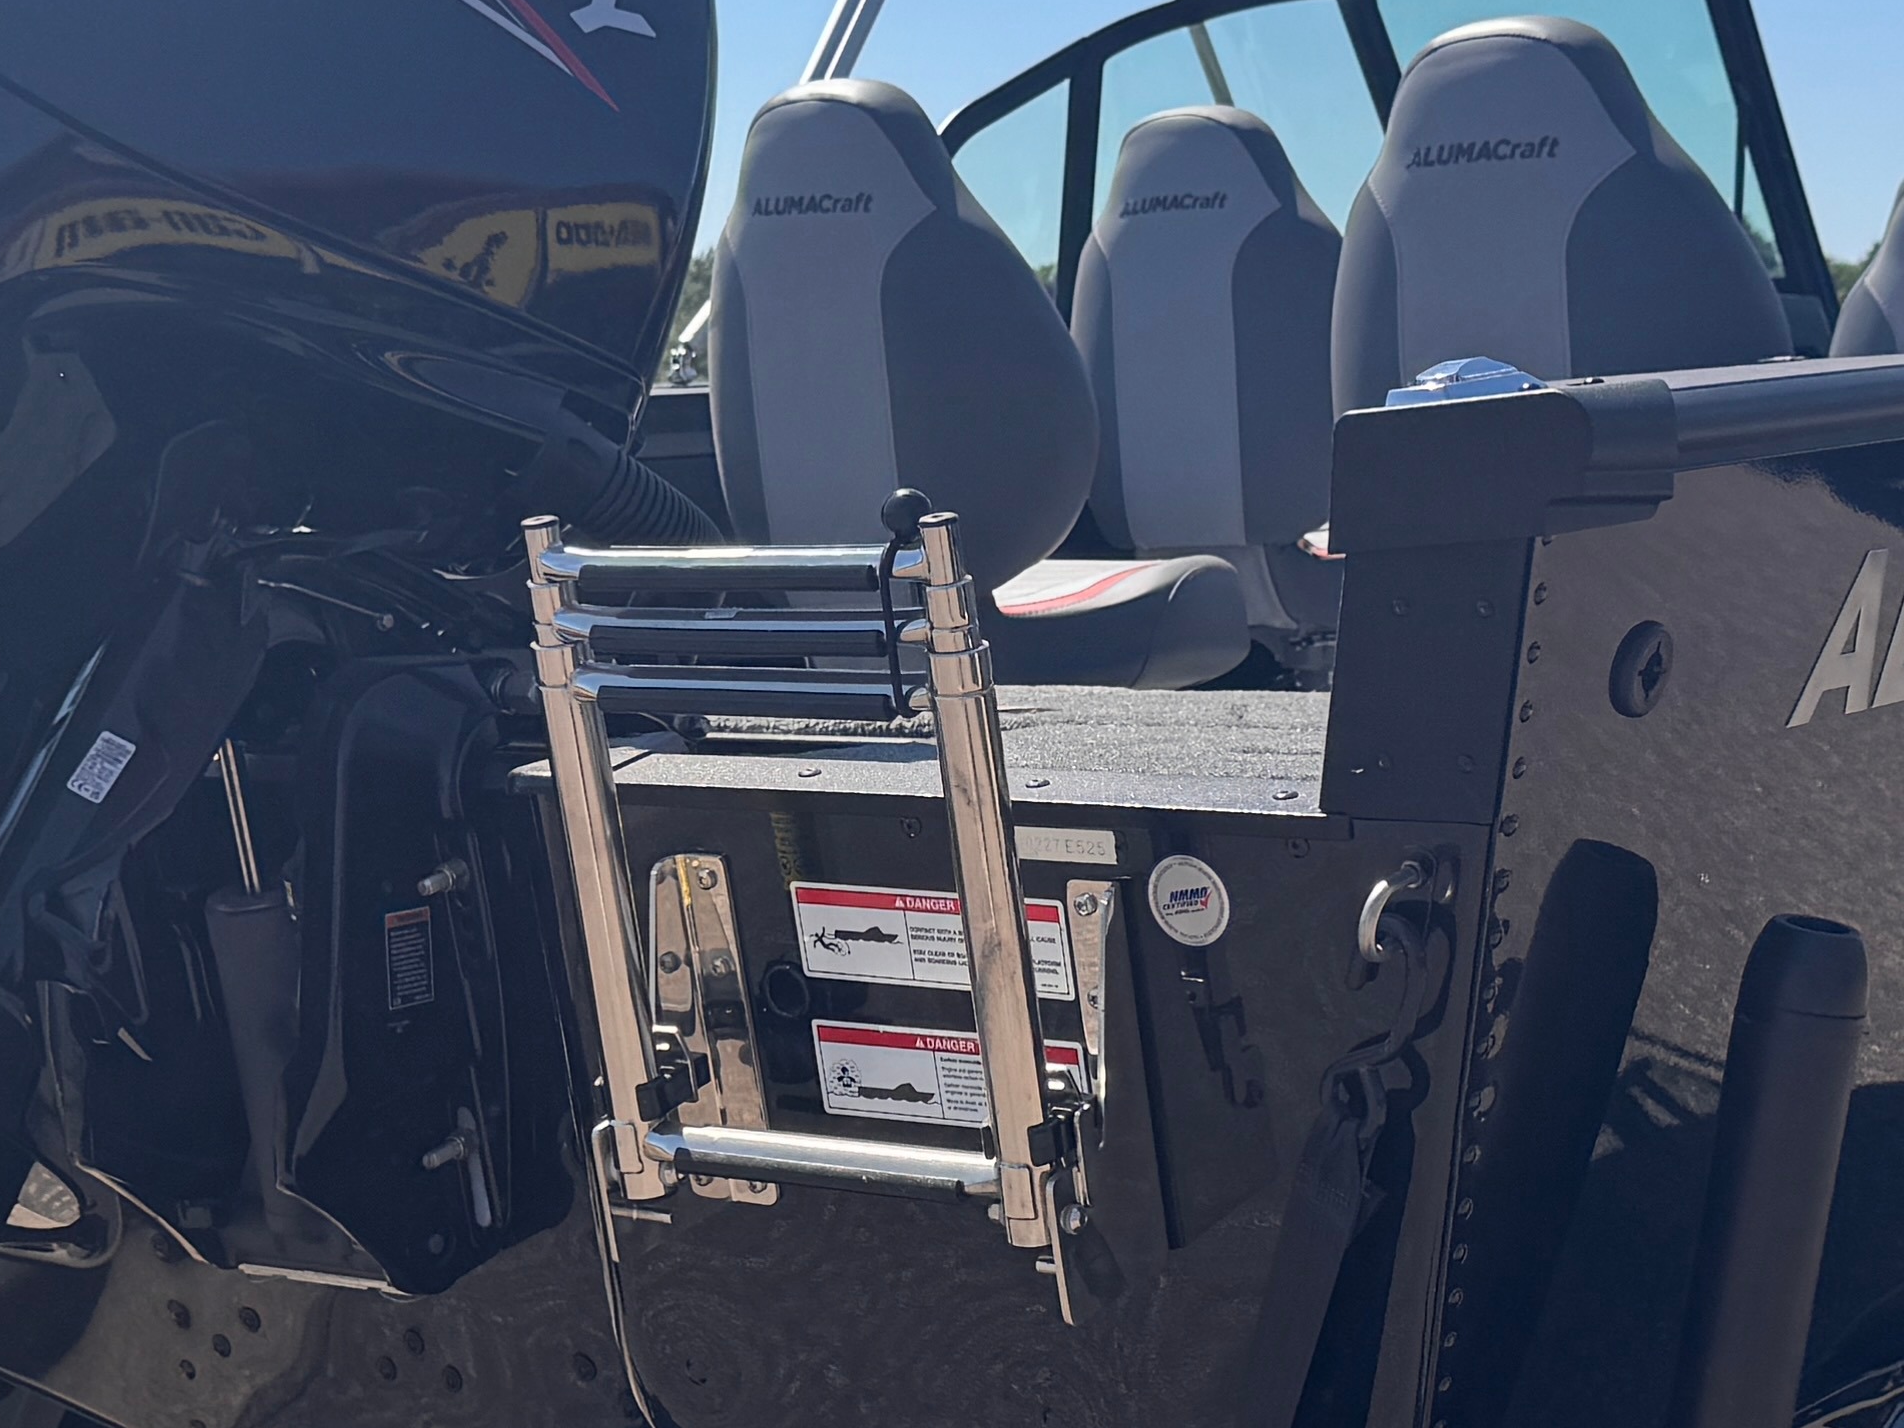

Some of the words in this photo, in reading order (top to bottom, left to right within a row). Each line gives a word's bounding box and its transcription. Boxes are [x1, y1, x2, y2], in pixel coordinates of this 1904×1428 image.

[1405, 135, 1559, 170] ALUMACraft
[752, 191, 874, 217] ALUMACraft
[1118, 190, 1229, 219] ALUMACraft
[906, 897, 955, 911] DANGER
[926, 1039, 976, 1053] DANGER
